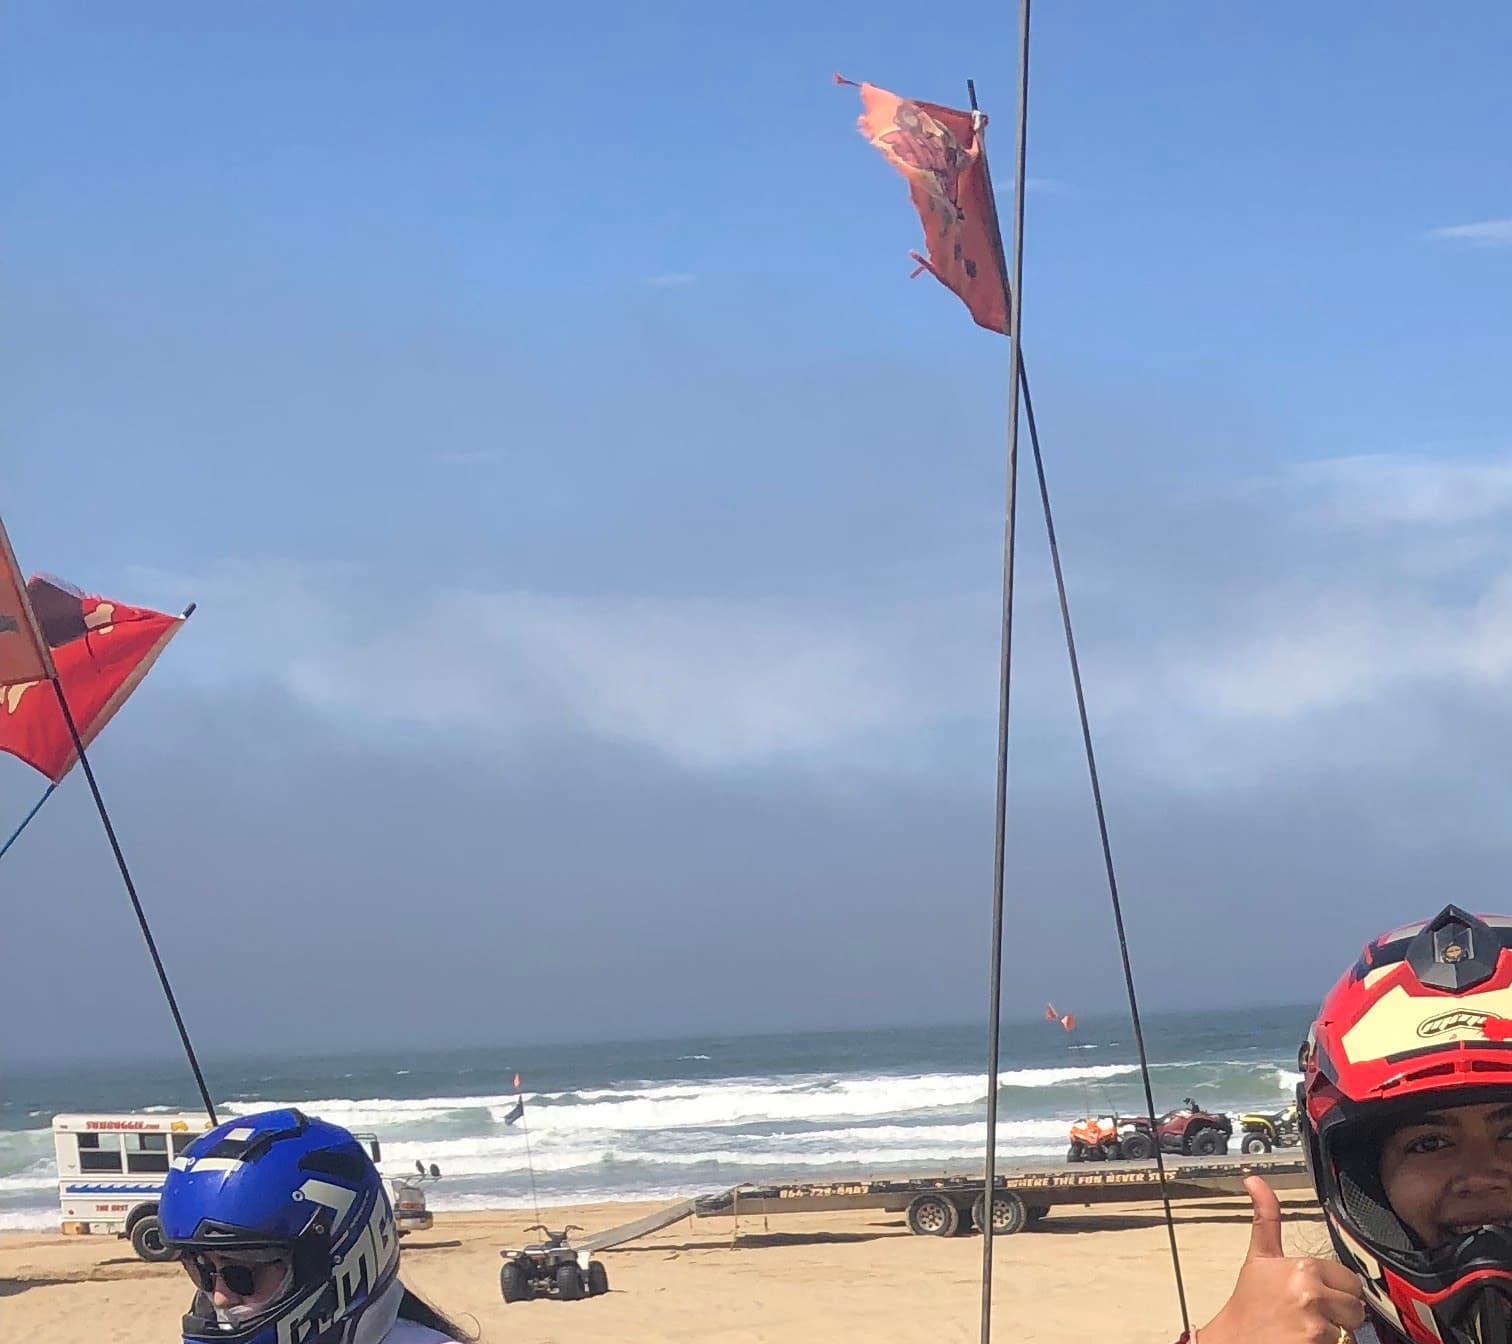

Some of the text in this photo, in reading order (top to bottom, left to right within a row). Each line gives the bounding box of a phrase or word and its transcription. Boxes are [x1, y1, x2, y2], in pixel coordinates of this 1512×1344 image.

[1007, 1177, 1049, 1188] WHERE
[1054, 1176, 1075, 1185] THE
[1078, 1174, 1102, 1185] FUN
[1106, 1173, 1145, 1183] NEVER
